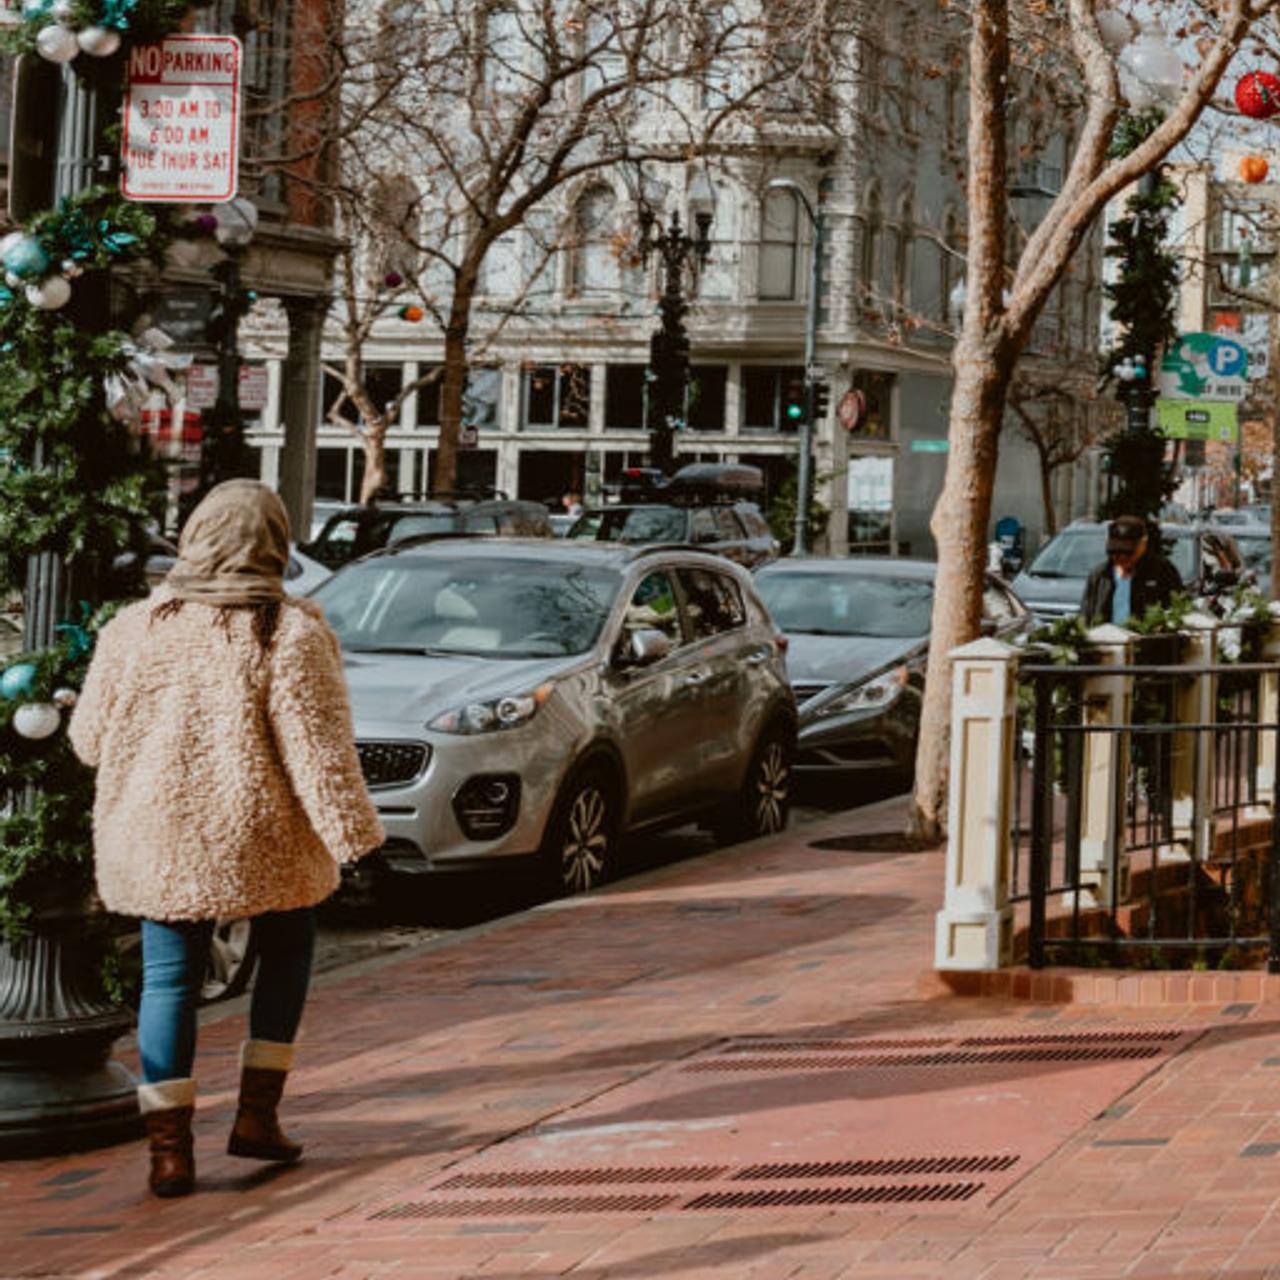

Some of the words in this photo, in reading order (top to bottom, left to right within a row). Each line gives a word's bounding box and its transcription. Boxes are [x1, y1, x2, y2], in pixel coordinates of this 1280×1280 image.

[130, 45, 161, 77] NO
[162, 51, 234, 73] PARKING
[178, 100, 199, 119] AM
[203, 100, 222, 119] TO
[188, 127, 209, 145] AM
[129, 150, 158, 170] TUE
[161, 150, 198, 170] THUR
[202, 150, 228, 171] SAT
